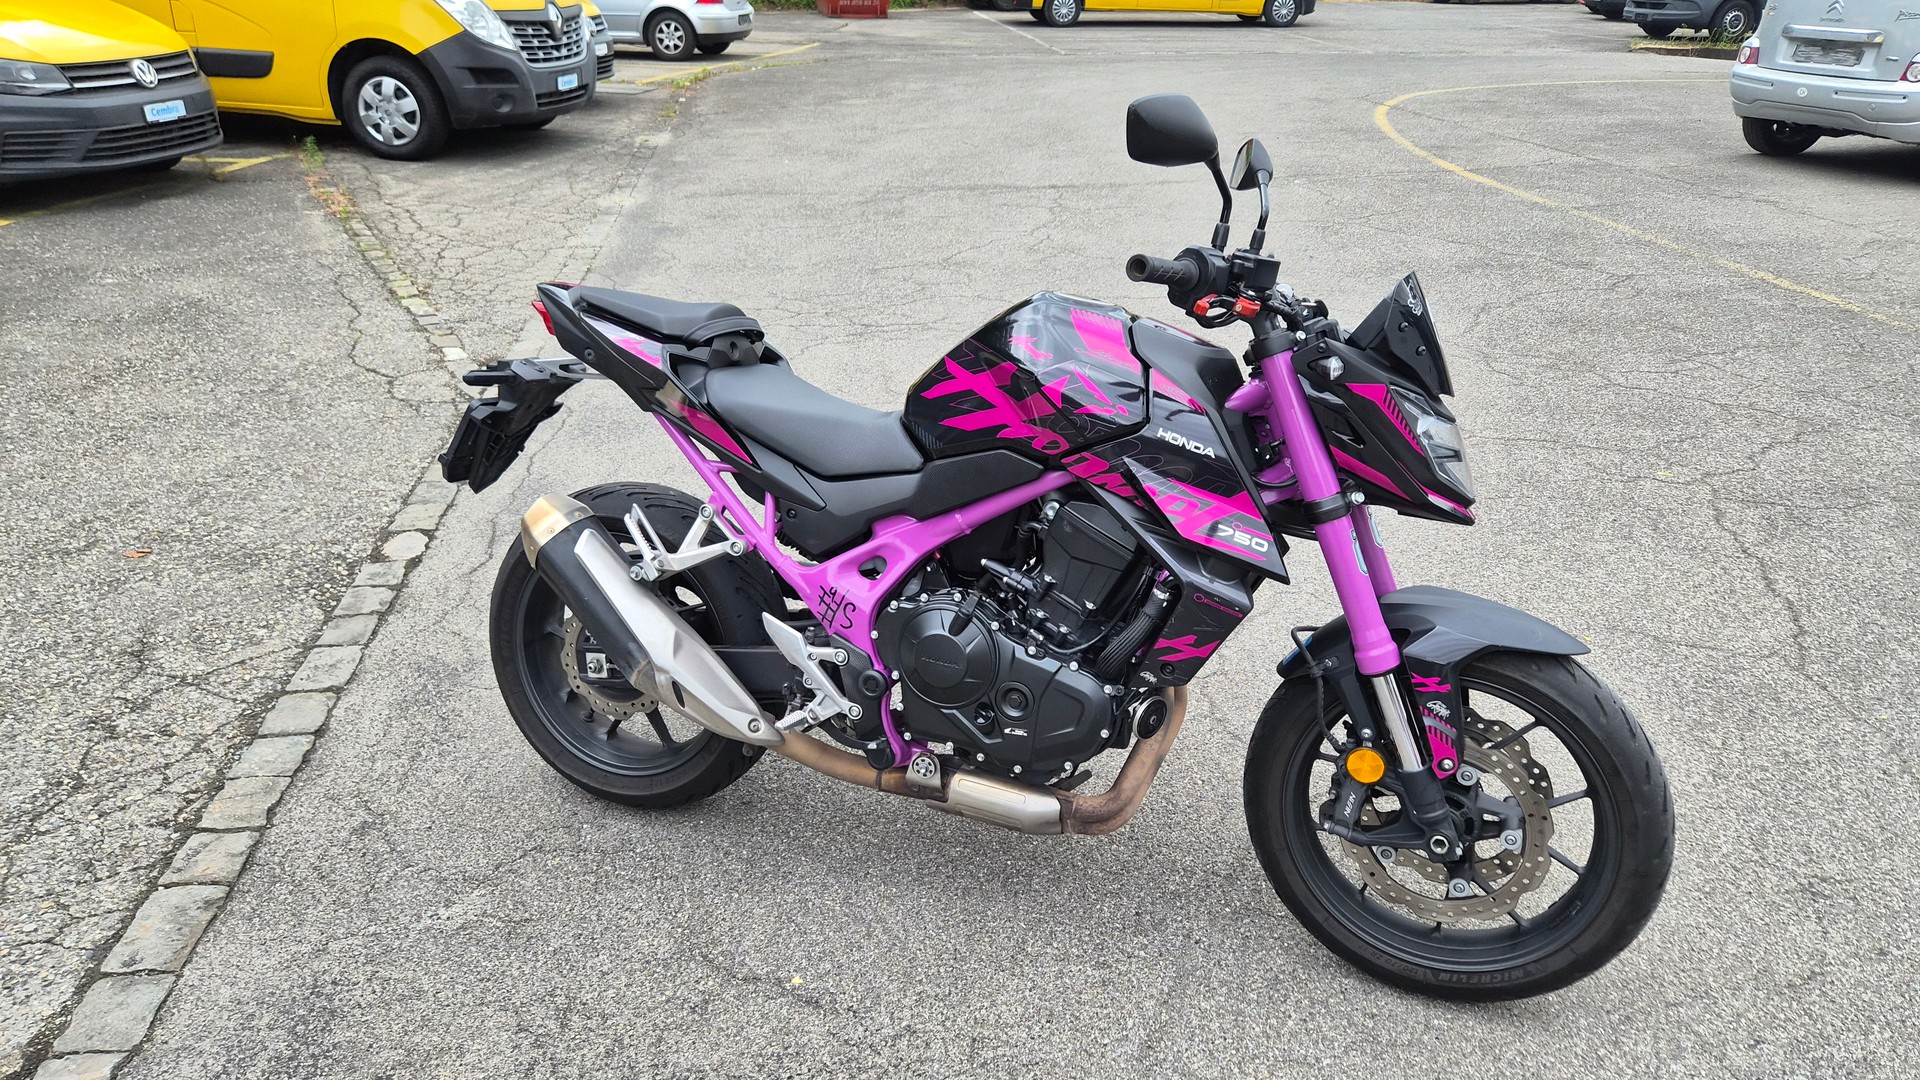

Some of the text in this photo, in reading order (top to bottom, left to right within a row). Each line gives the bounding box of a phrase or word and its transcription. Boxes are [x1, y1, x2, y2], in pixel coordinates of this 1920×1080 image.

[1156, 427, 1216, 459] HONDA
[1217, 523, 1269, 553] 750
[1438, 968, 1525, 984] MICHELIN
